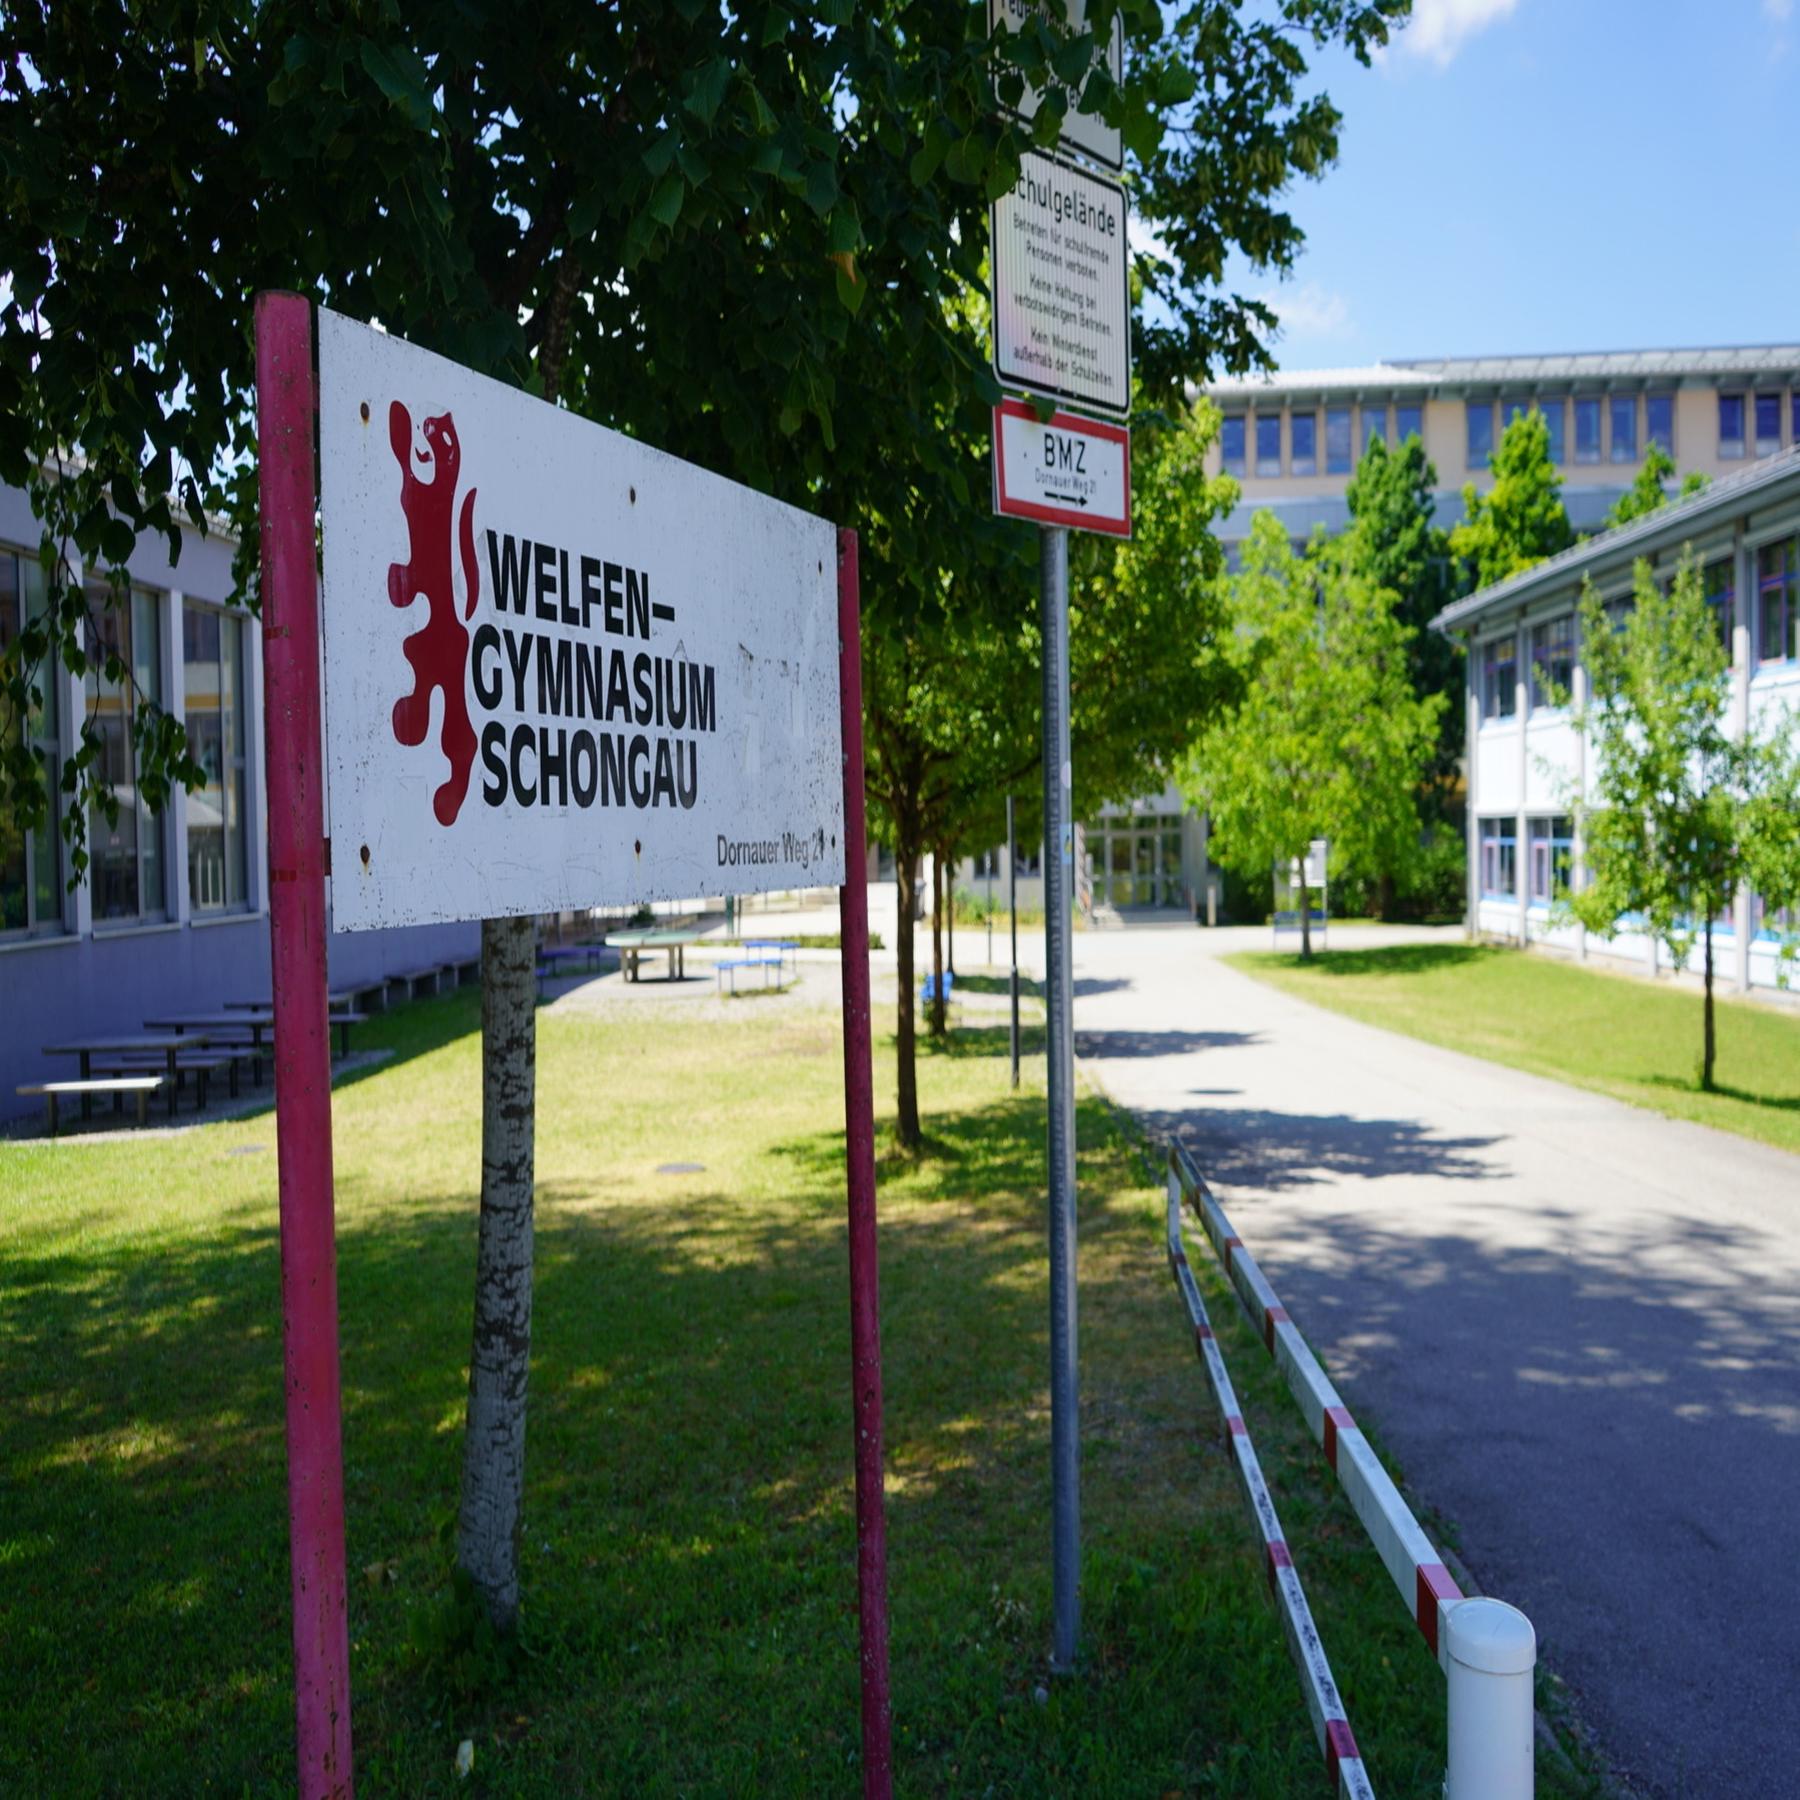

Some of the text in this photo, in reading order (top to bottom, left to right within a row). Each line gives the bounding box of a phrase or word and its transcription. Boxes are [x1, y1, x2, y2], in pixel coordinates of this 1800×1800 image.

[1008, 169, 1115, 237] chulgelände
[1013, 212, 1109, 265] Betreten für schulfremde
[1026, 239, 1062, 267] Personen
[1013, 293, 1077, 325] verbotswidrigem
[1030, 272, 1096, 310] Keine Haftung bei
[1013, 345, 1053, 369] außerhalb
[1055, 357, 1069, 373] der
[1030, 325, 1097, 360] Kein Winterdienst
[1044, 432, 1086, 475] BMZ
[1035, 467, 1097, 495] Dornauer Weg 21
[486, 529, 675, 640] WELFEN-
[472, 624, 716, 732] GYMNASIUM
[481, 720, 698, 809] SCHONGAU
[717, 834, 780, 867] Dornauer
[782, 832, 809, 869] Weg
